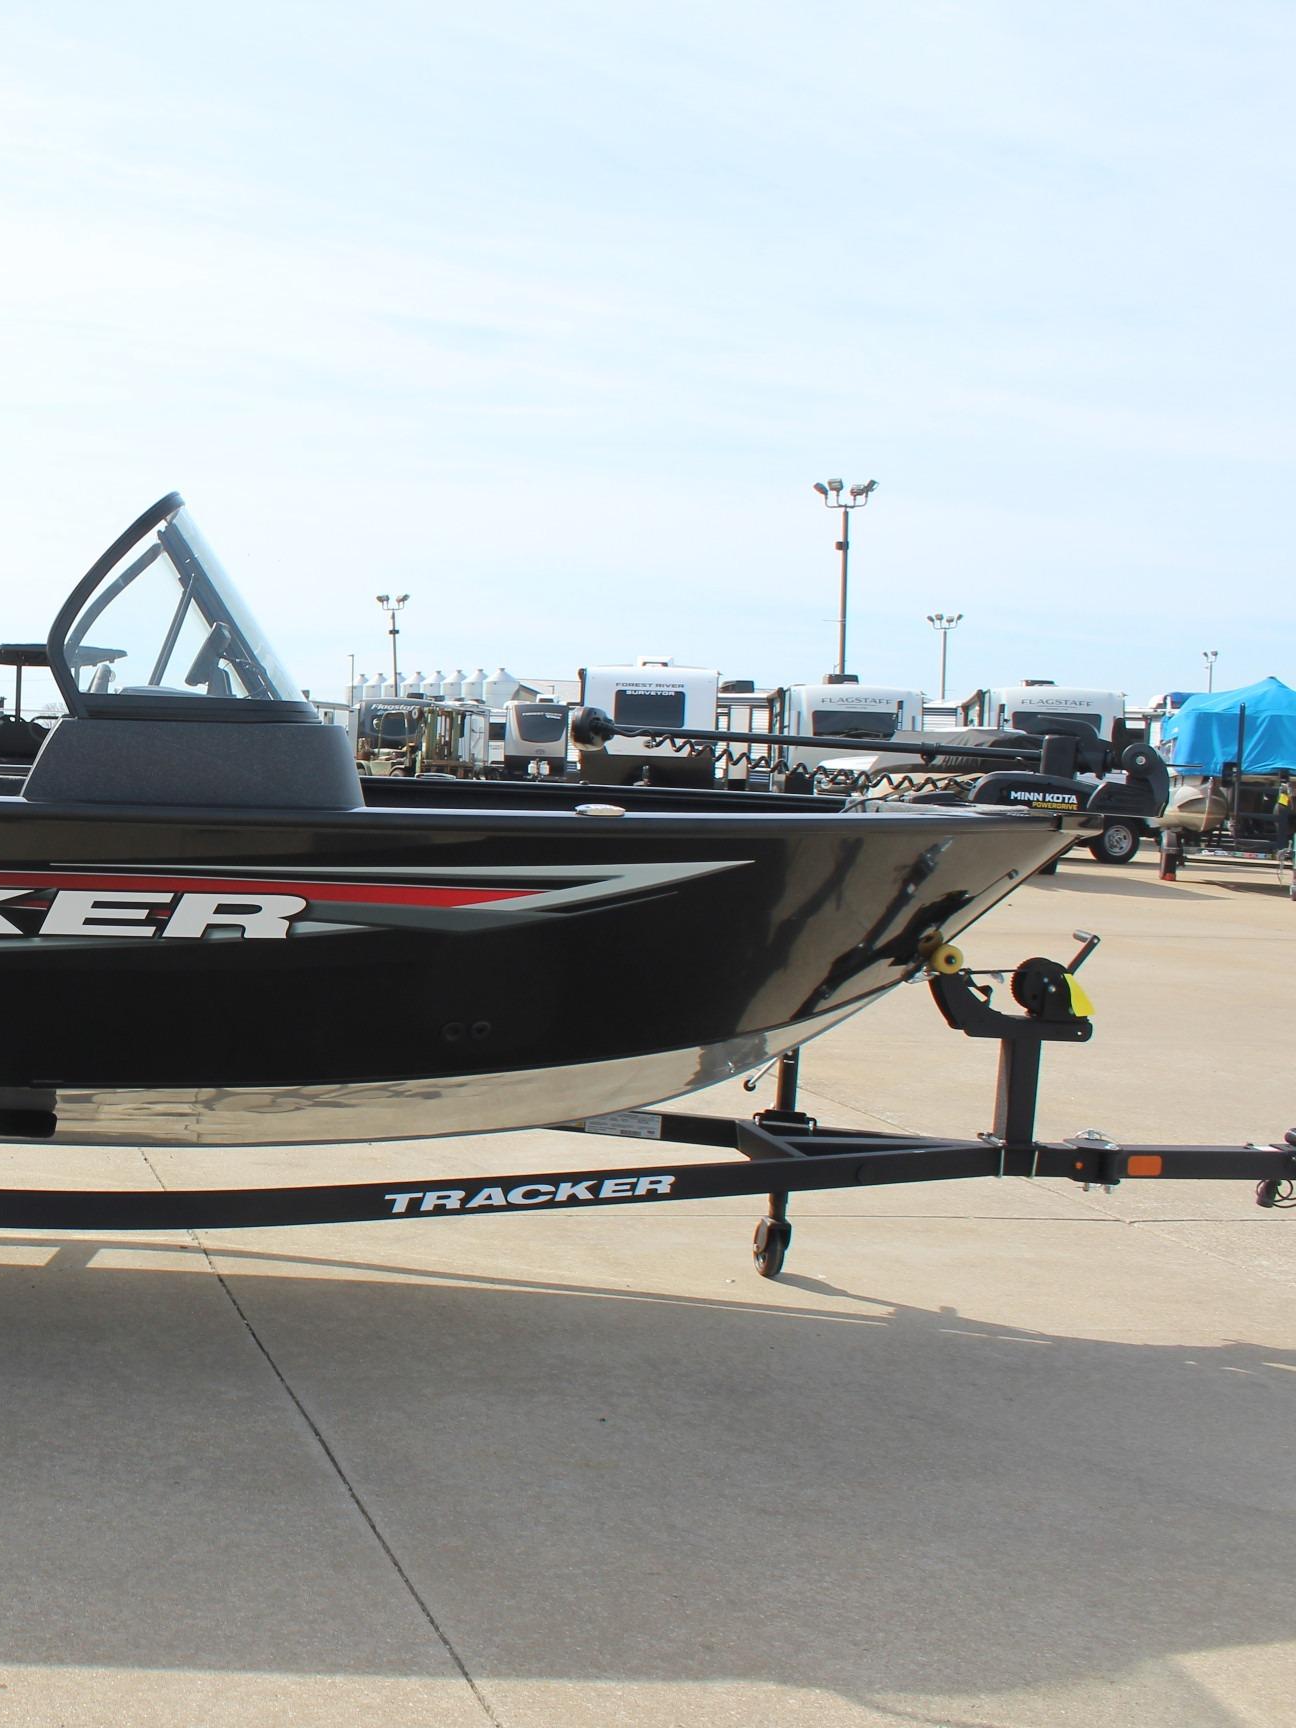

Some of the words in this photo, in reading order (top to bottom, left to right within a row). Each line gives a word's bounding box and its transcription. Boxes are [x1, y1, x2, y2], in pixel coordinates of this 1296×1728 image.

[1010, 790, 1044, 801] MINN
[1045, 793, 1078, 804] KOTA
[1032, 801, 1079, 811] POWERDRIVE
[384, 1174, 676, 1214] TRACKER
